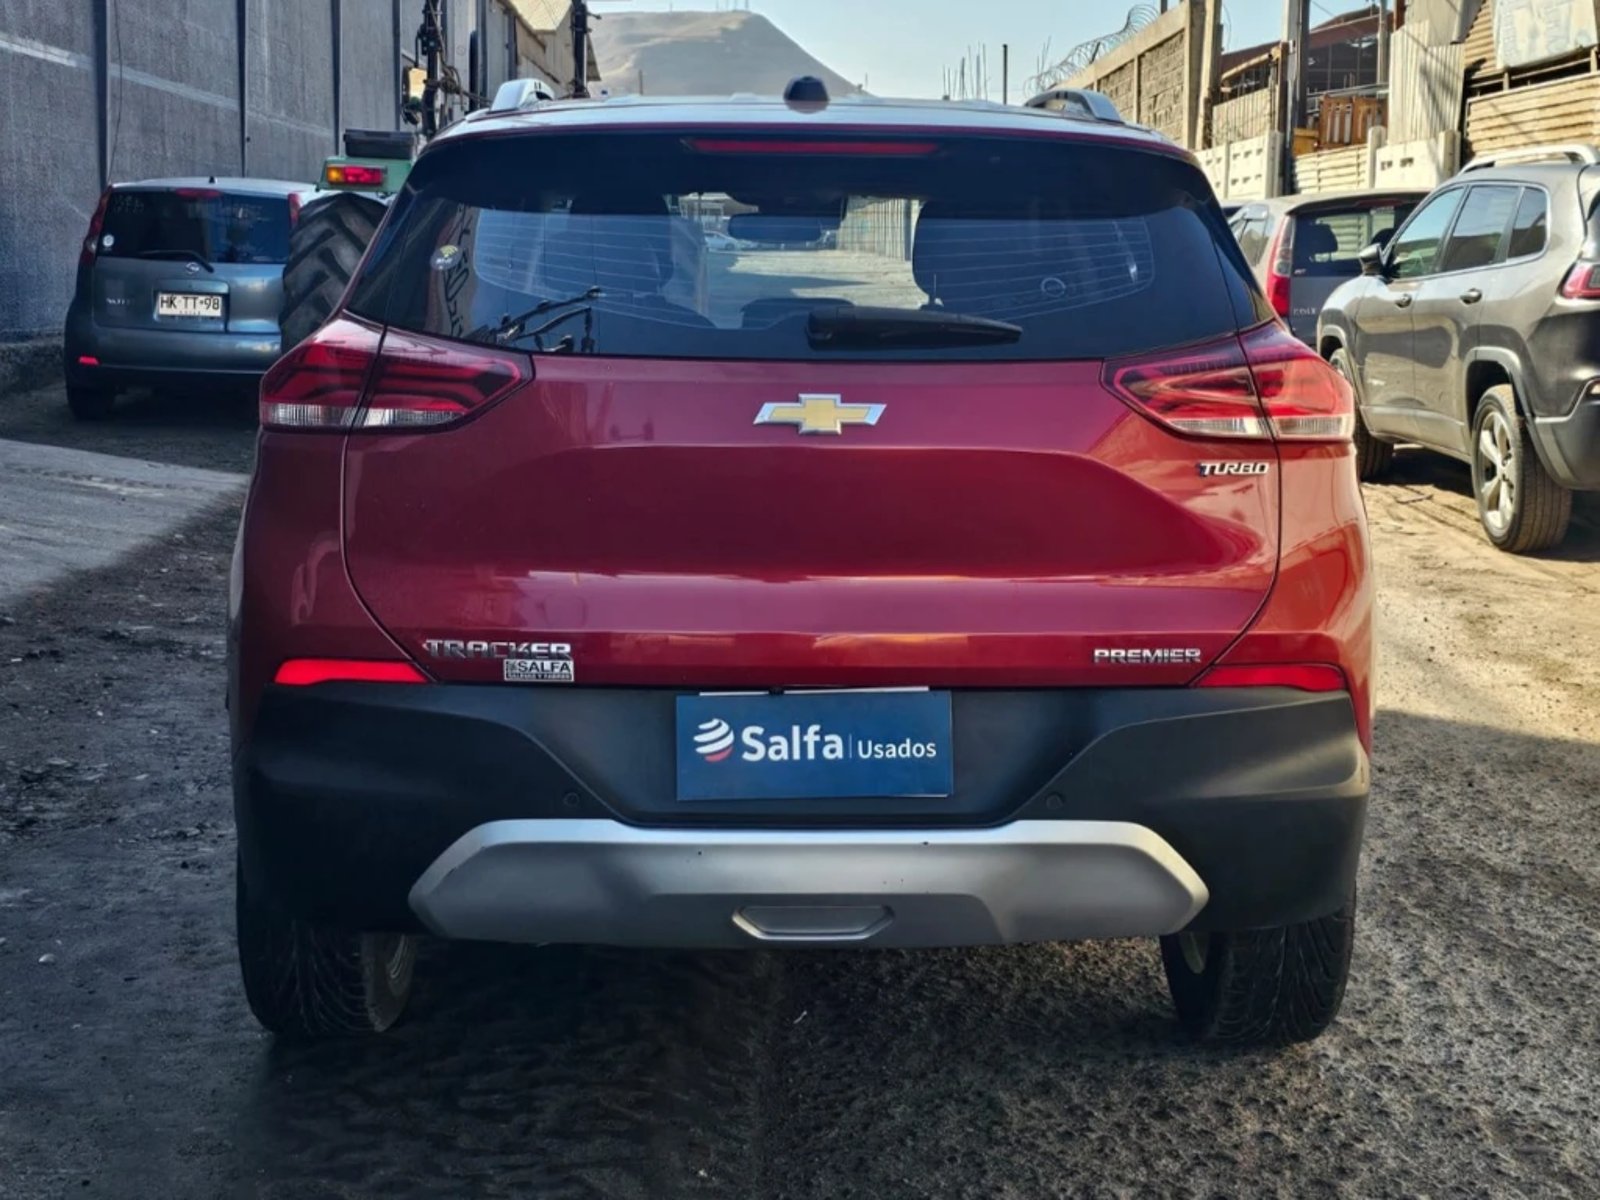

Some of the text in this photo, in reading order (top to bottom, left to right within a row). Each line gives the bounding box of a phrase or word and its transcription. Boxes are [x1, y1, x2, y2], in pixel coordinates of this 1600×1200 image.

[1198, 462, 1270, 476] TURBO
[423, 639, 572, 659] TRACKER
[1093, 648, 1201, 663] PREMIER
[518, 661, 571, 673] SALFA
[741, 724, 937, 762] Salfa Usados
